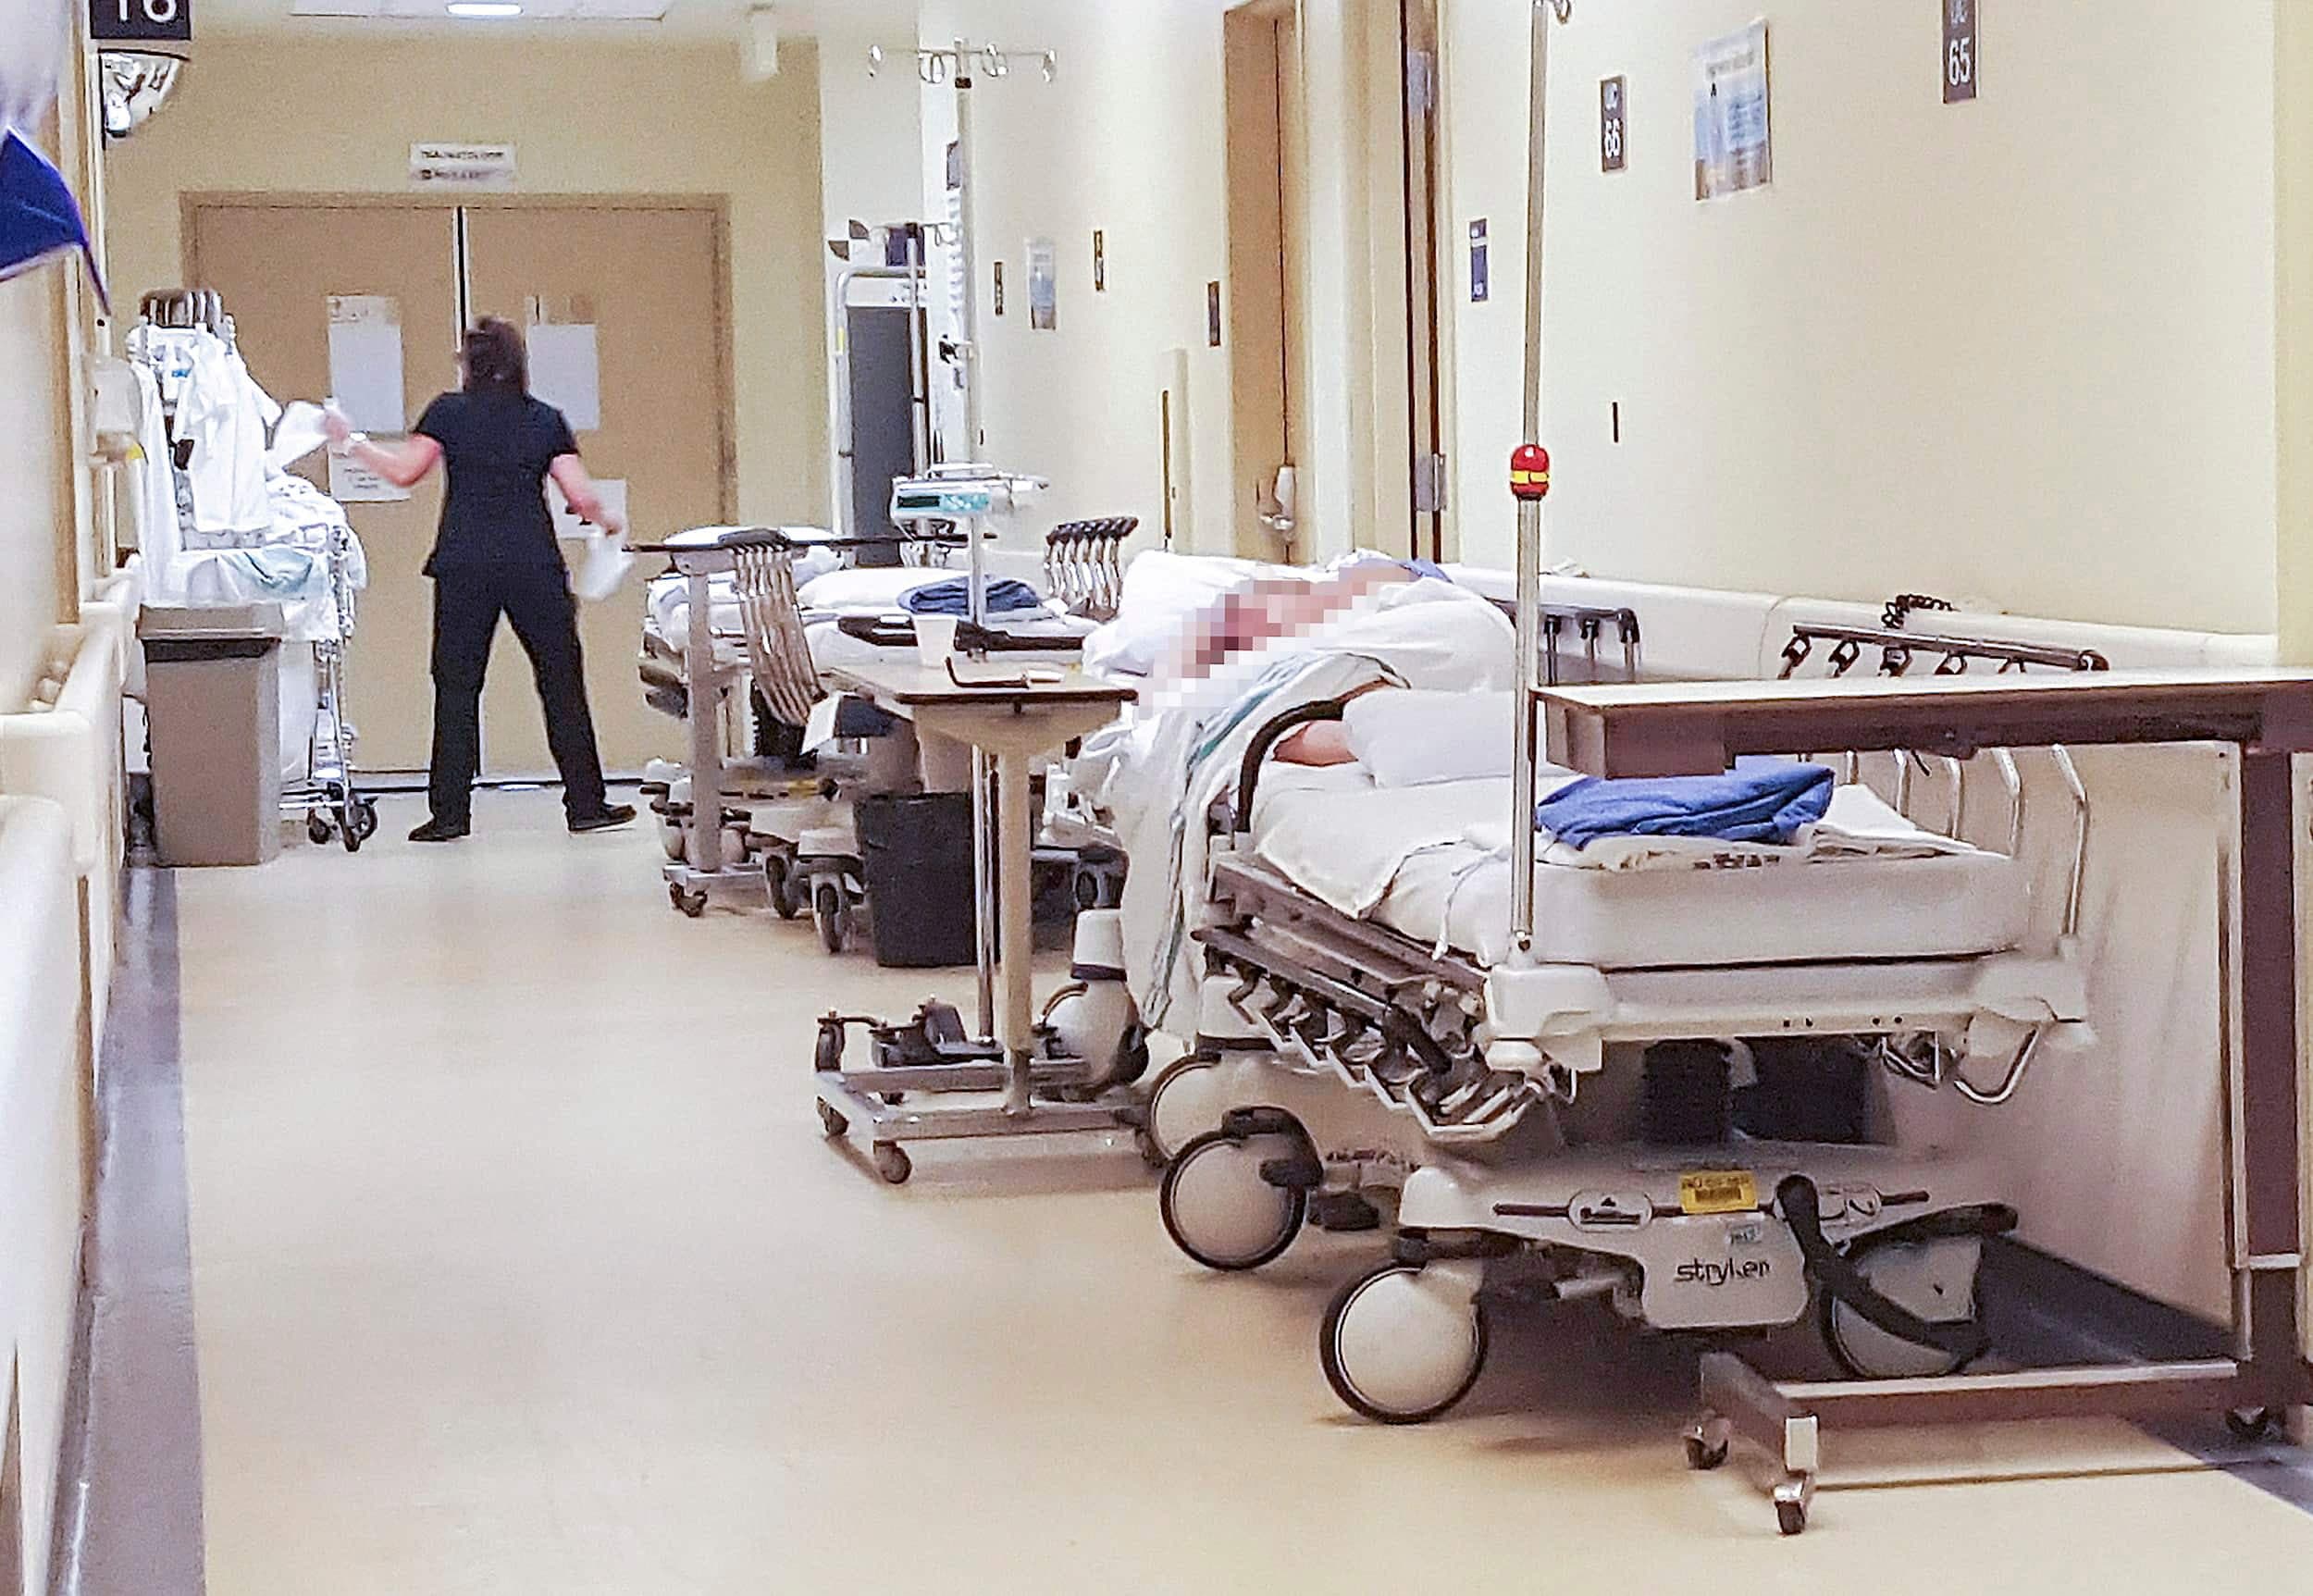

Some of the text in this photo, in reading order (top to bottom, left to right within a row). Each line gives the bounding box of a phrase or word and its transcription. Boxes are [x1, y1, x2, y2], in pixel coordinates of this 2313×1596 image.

[1948, 37, 1971, 86] 65
[1604, 118, 1620, 158] 66
[1675, 1257, 1771, 1286] stryker
